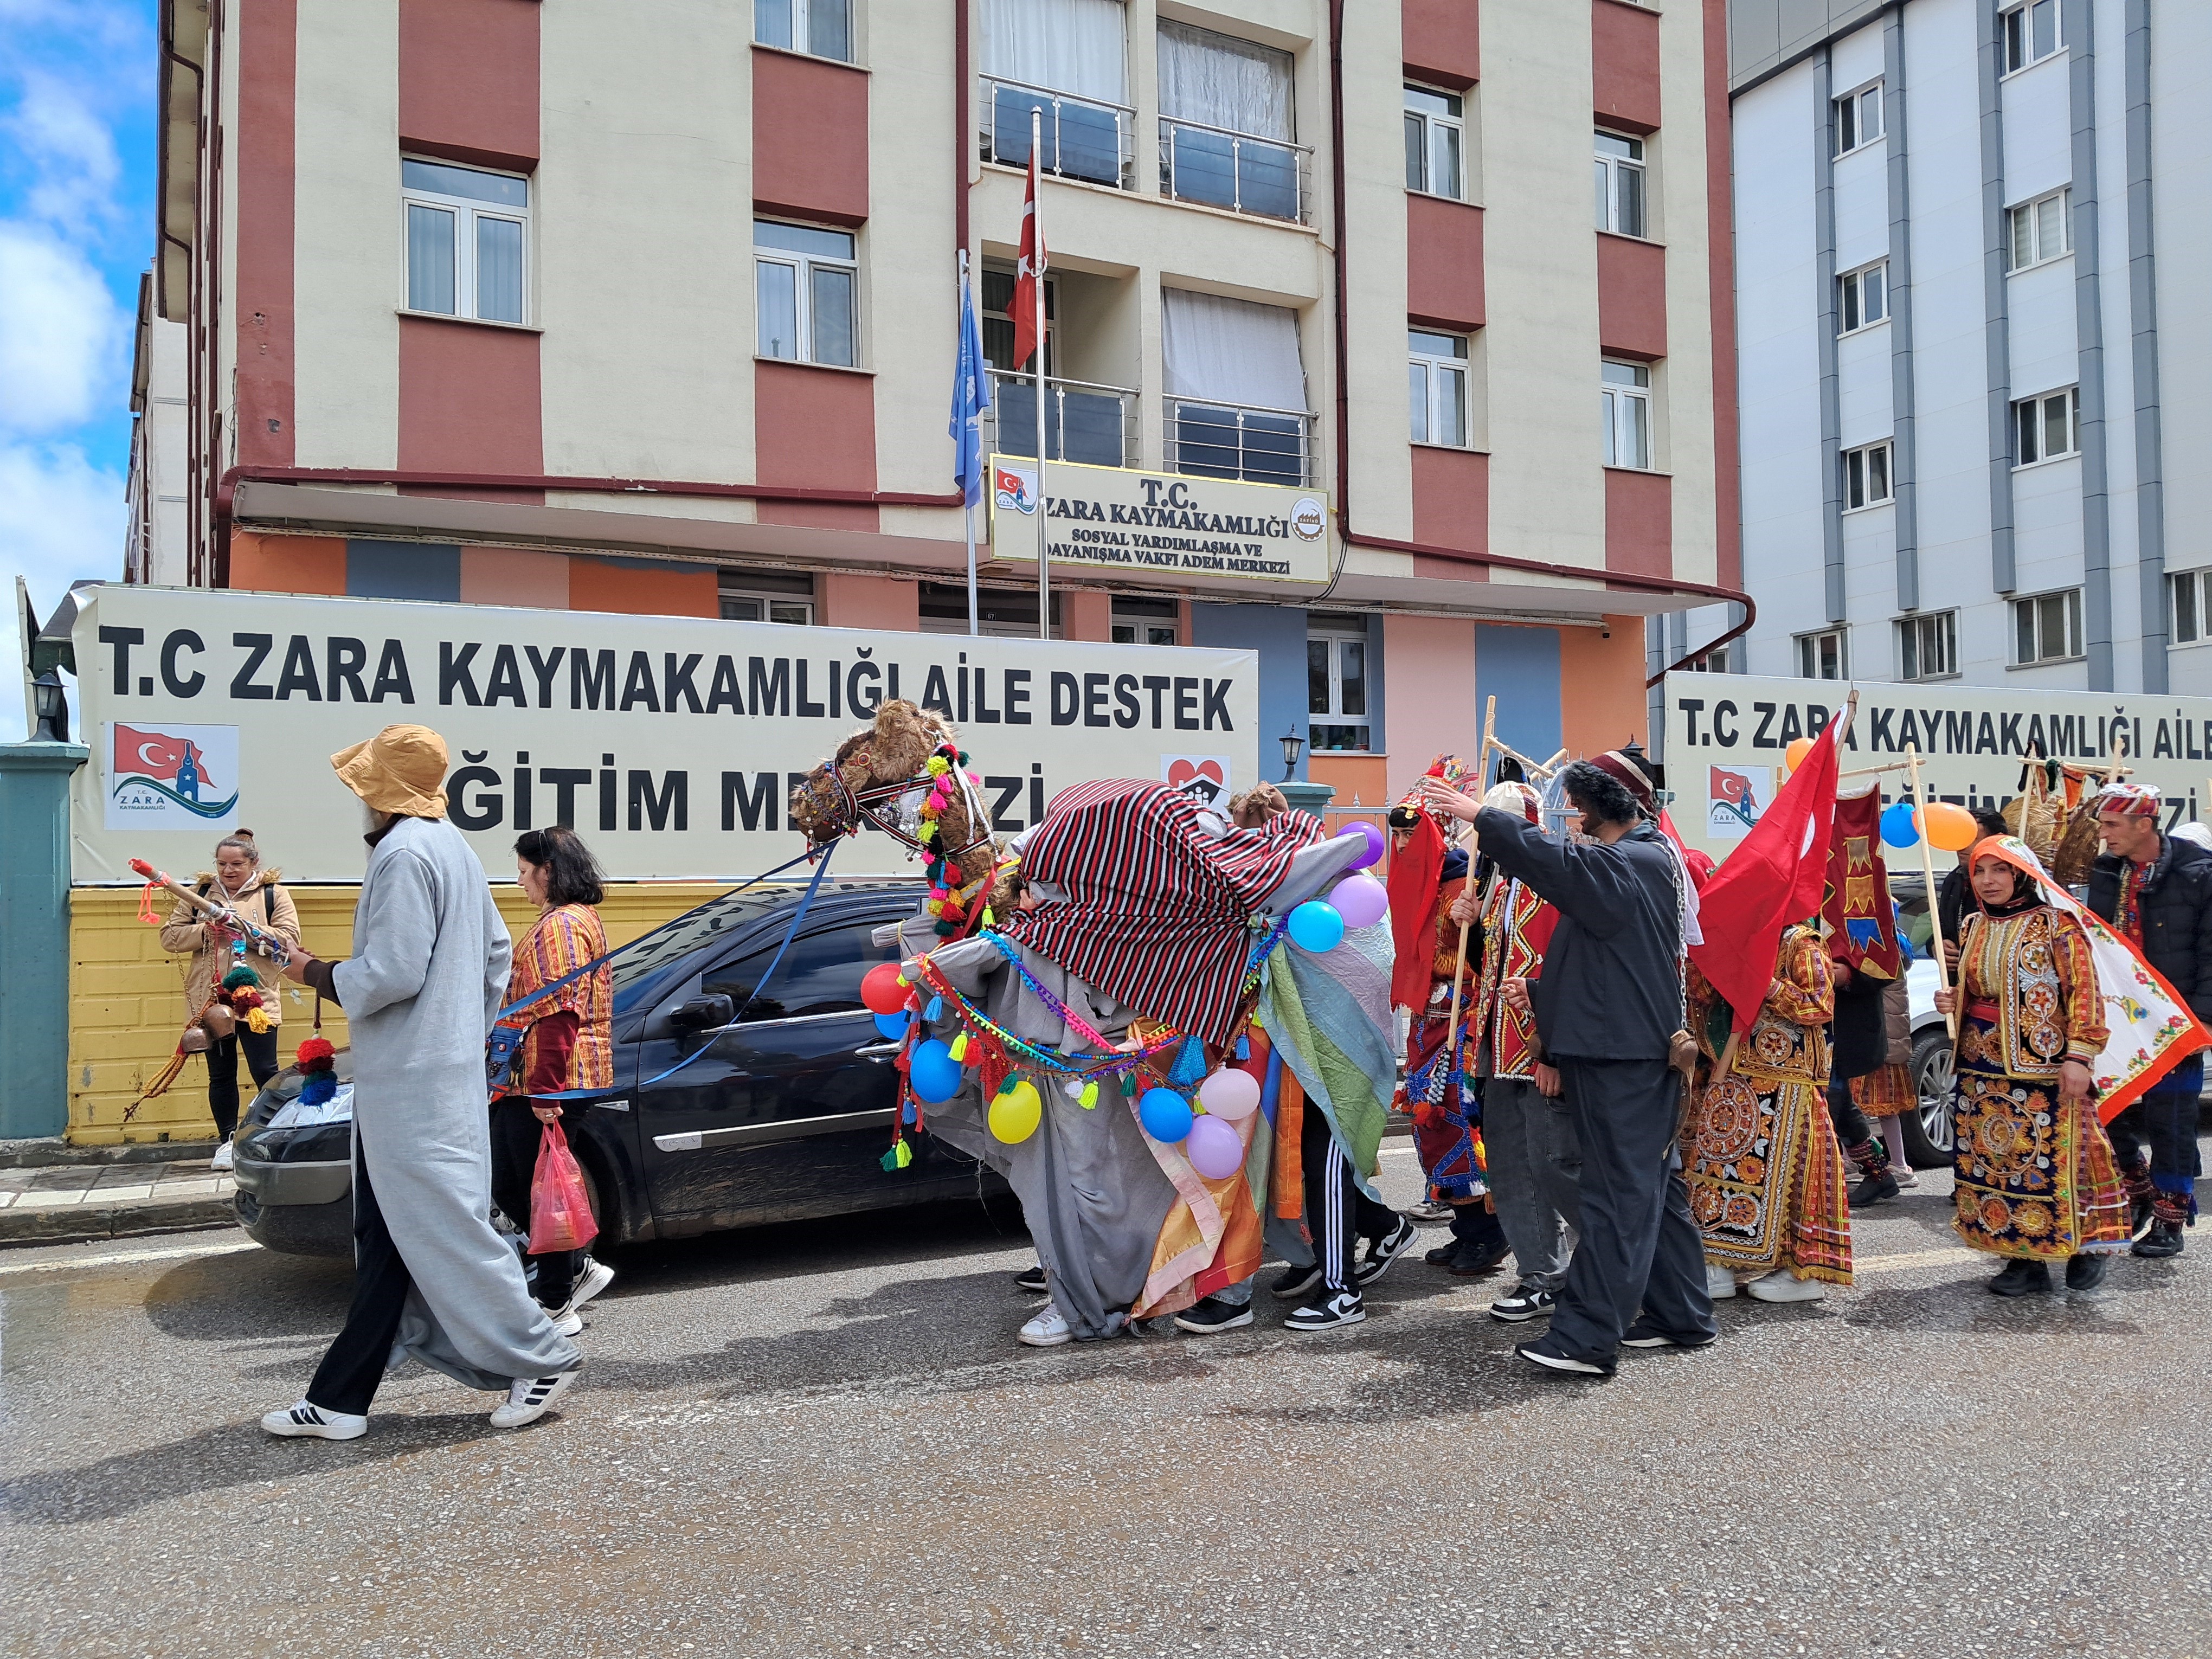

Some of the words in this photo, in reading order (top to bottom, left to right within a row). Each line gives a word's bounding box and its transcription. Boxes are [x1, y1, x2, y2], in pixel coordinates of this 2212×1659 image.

[1141, 479, 1197, 510] T.C.
[1046, 497, 1106, 522] ZARA
[1109, 504, 1290, 538] KAYMAKAMLIĞI
[1072, 528, 1129, 546] SOSYAL
[1131, 533, 1242, 557] YARDIMLAŞMA
[1244, 544, 1263, 557] VE
[1134, 550, 1179, 567] VAKFI
[1181, 554, 1224, 570] ADEM
[1226, 558, 1290, 575] MERKEZİ
[99, 626, 205, 698] T.C
[230, 633, 415, 704] ZARA
[439, 642, 899, 722] KAYMAKAMLIĞI
[921, 652, 1031, 725] AİLE
[1051, 671, 1234, 731] DESTEK
[1679, 699, 1739, 748] T.C
[1871, 705, 2141, 758] KAYMAKAMLIĞI
[120, 796, 165, 804] ZARA
[446, 750, 687, 832] ĞİTİM
